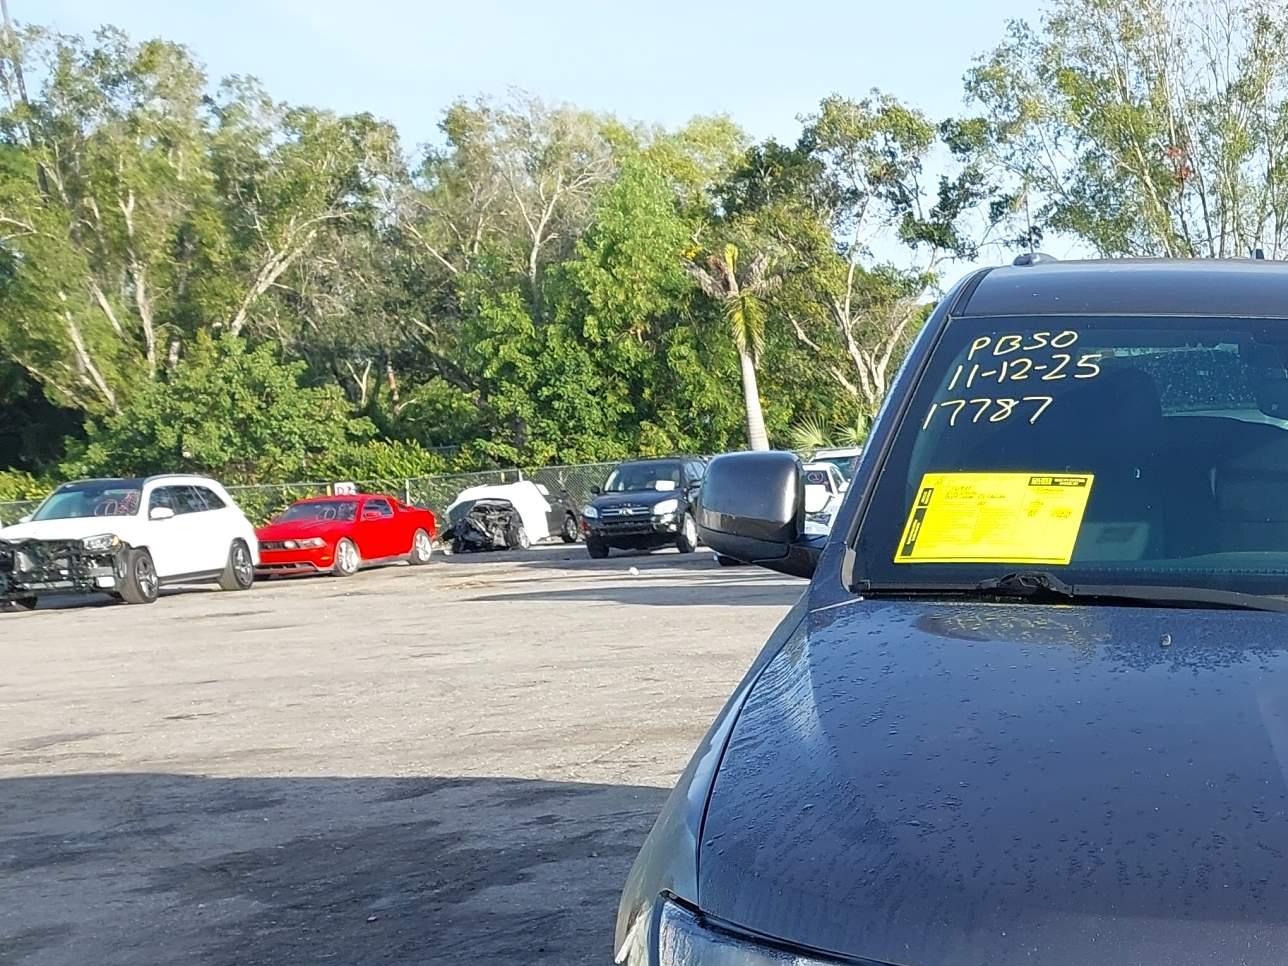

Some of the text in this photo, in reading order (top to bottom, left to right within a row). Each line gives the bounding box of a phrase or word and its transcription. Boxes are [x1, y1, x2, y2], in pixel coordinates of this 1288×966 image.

[967, 330, 1079, 361] PBSO
[947, 353, 1104, 391] 11-12-25
[922, 395, 1054, 431] 17787
